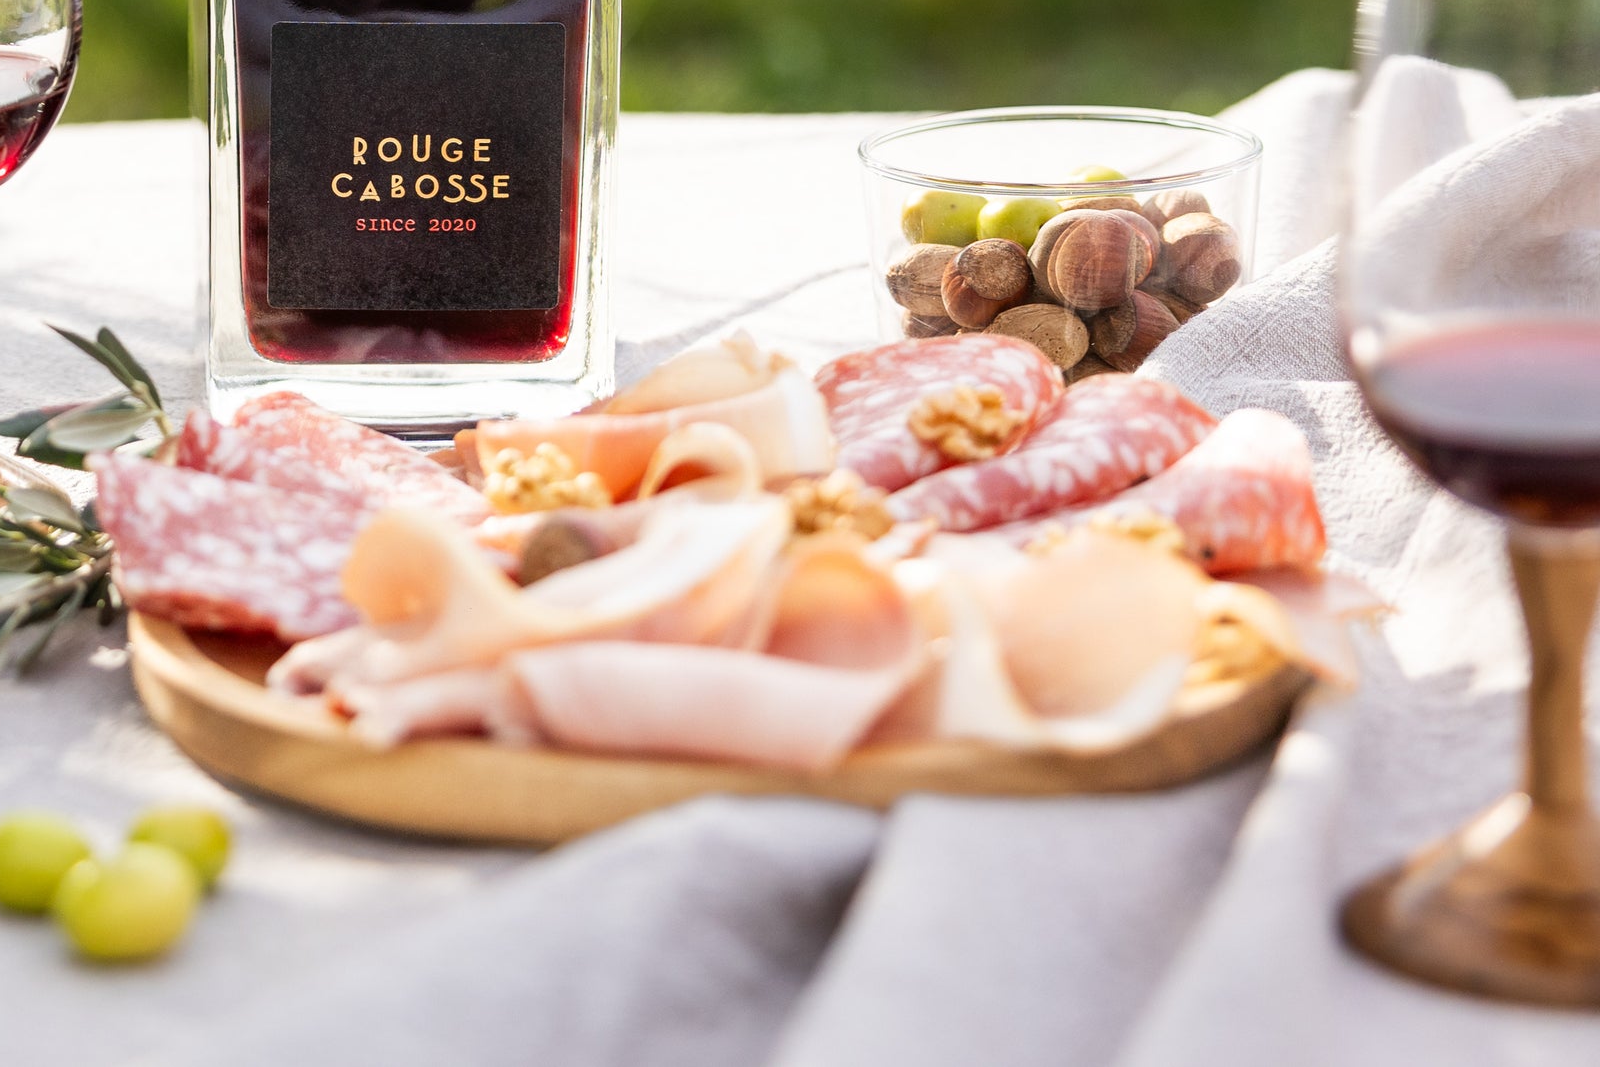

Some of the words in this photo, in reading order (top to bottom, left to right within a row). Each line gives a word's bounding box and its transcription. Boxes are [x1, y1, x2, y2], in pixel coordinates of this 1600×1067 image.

[352, 133, 492, 165] ROUGE
[331, 172, 511, 204] CABOSSE
[355, 217, 417, 232] since
[428, 217, 478, 232] 2020
